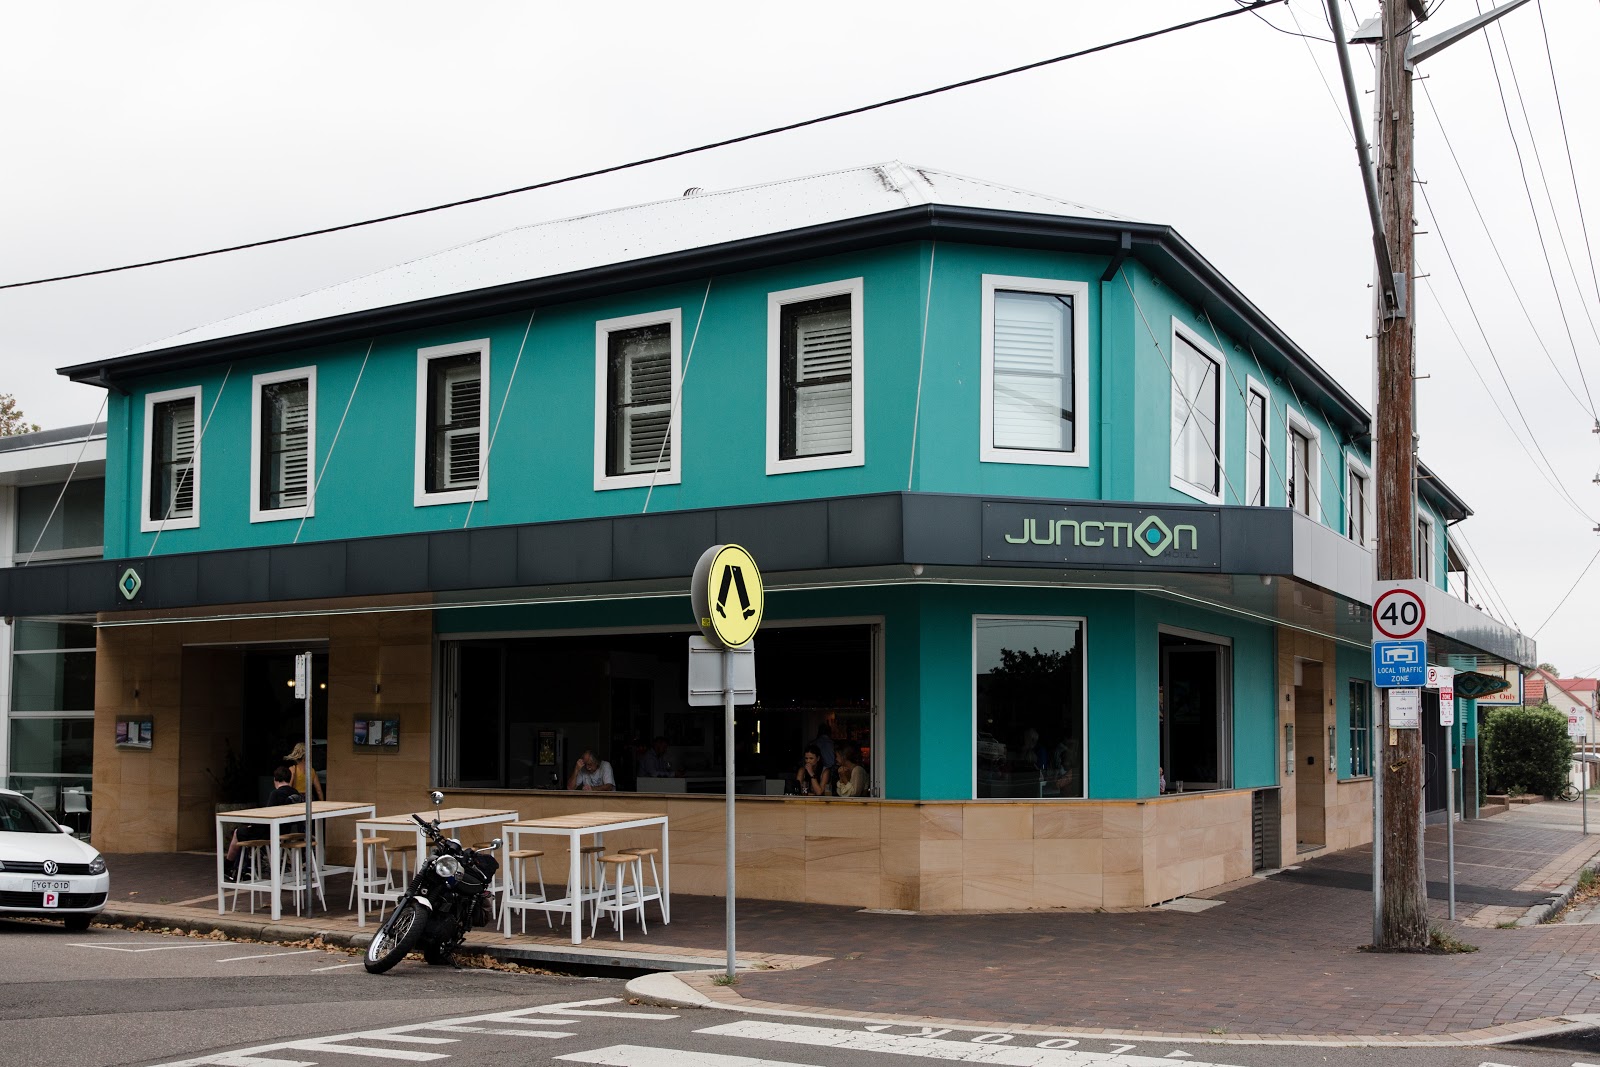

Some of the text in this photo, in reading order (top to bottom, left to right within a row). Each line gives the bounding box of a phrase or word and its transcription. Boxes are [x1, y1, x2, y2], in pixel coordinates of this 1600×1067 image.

[1004, 515, 1197, 557] JUNCTION
[1164, 551, 1198, 559] HOTEL
[1380, 601, 1418, 626] 40
[1499, 693, 1516, 701] Only
[46, 894, 55, 905] P
